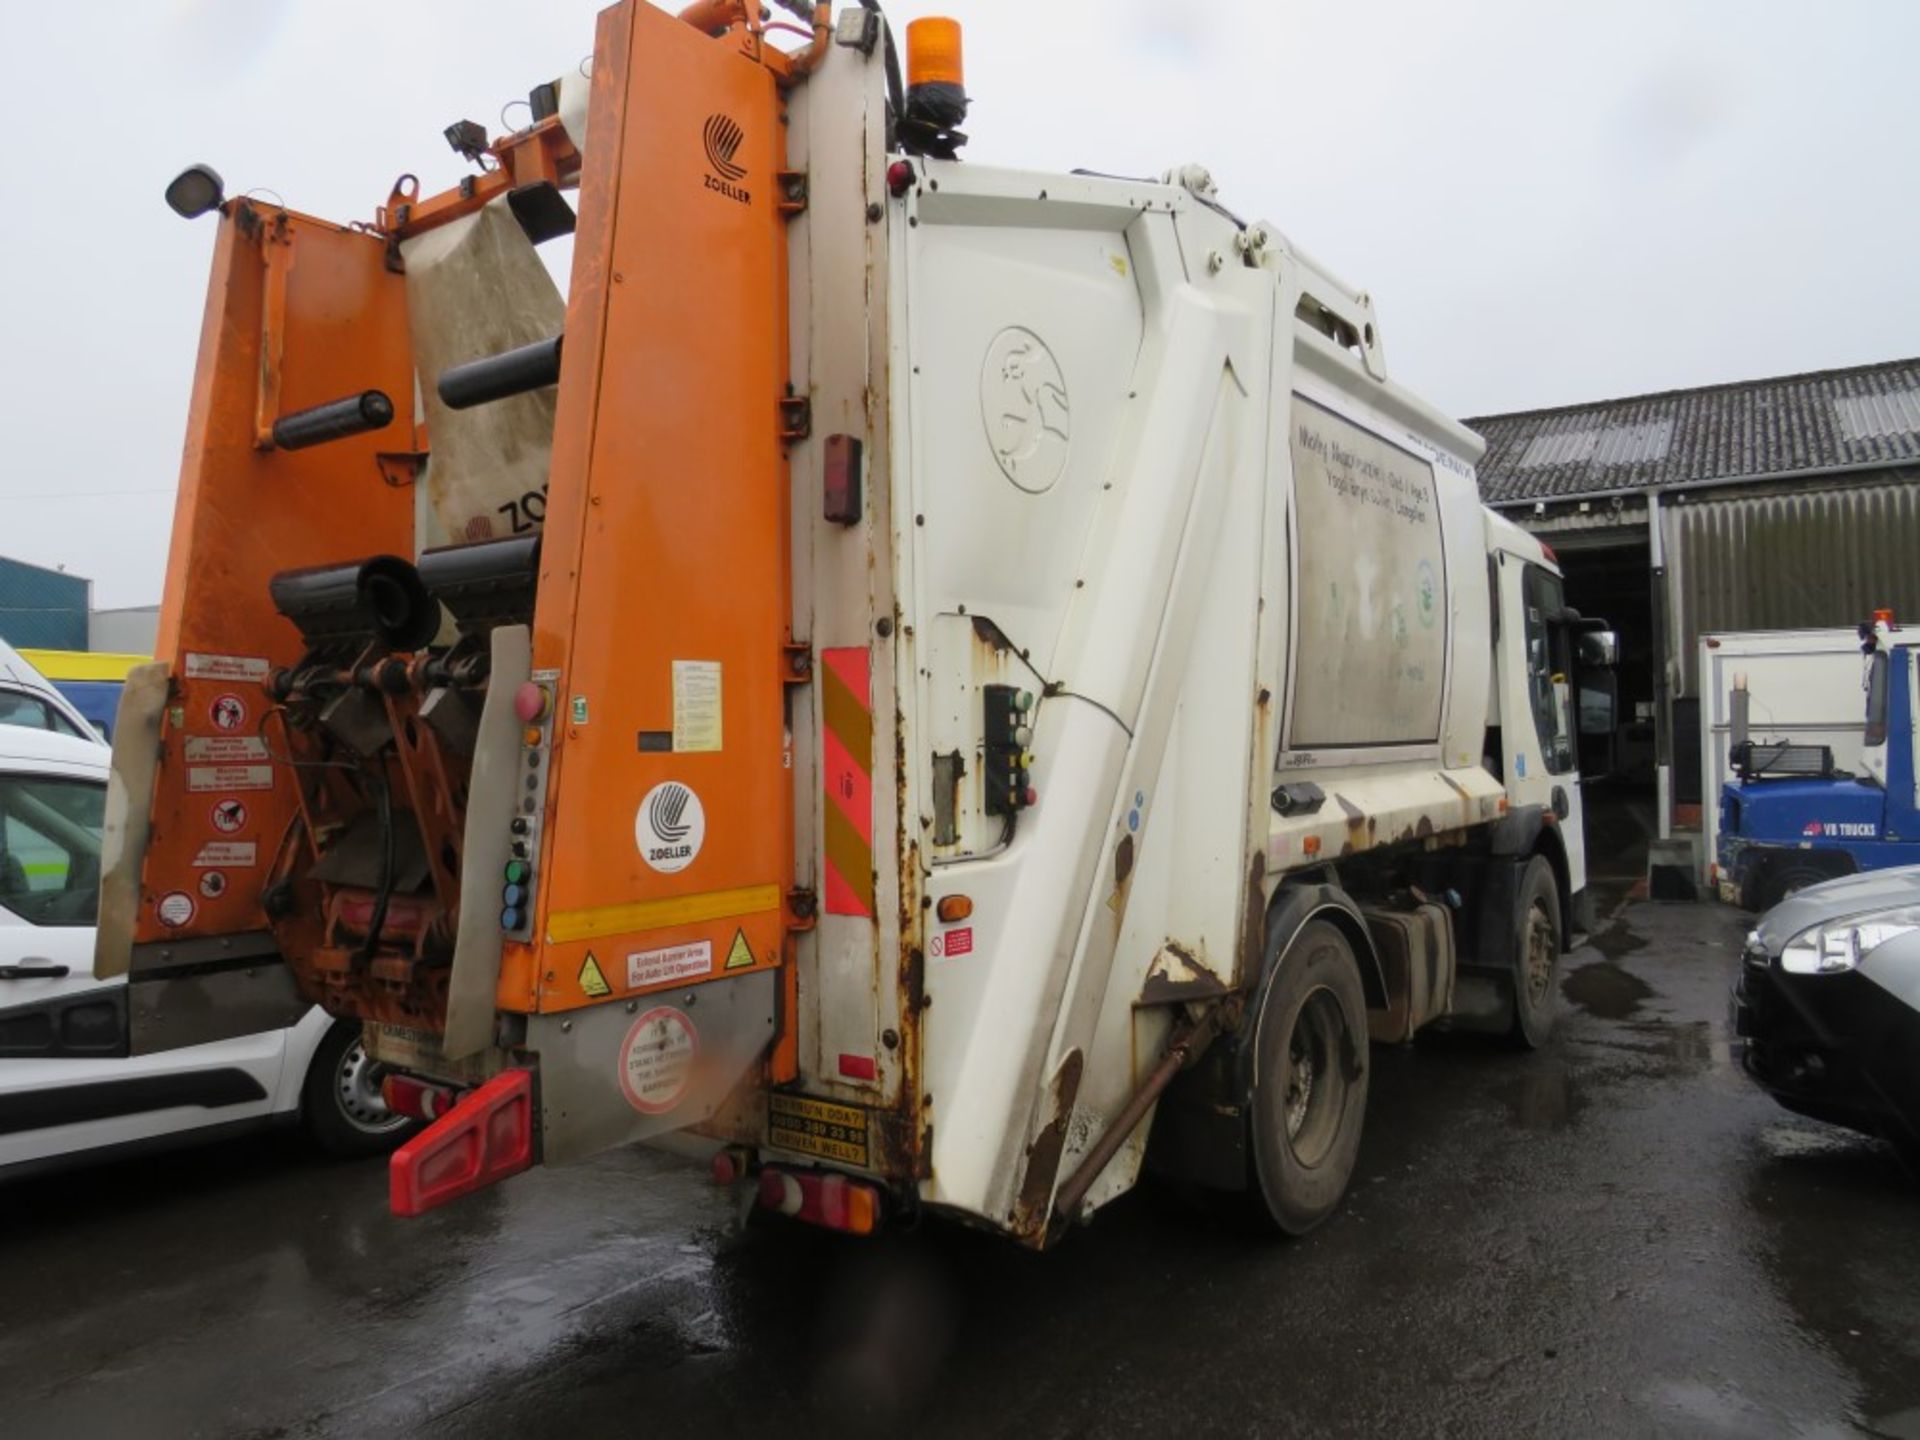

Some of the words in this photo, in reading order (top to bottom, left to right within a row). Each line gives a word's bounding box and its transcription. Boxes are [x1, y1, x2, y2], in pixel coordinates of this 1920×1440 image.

[704, 174, 752, 206] ZOELLER
[498, 484, 548, 533] ZO
[1839, 823, 1875, 836] TRUCKS
[650, 844, 692, 861] ZOELLER
